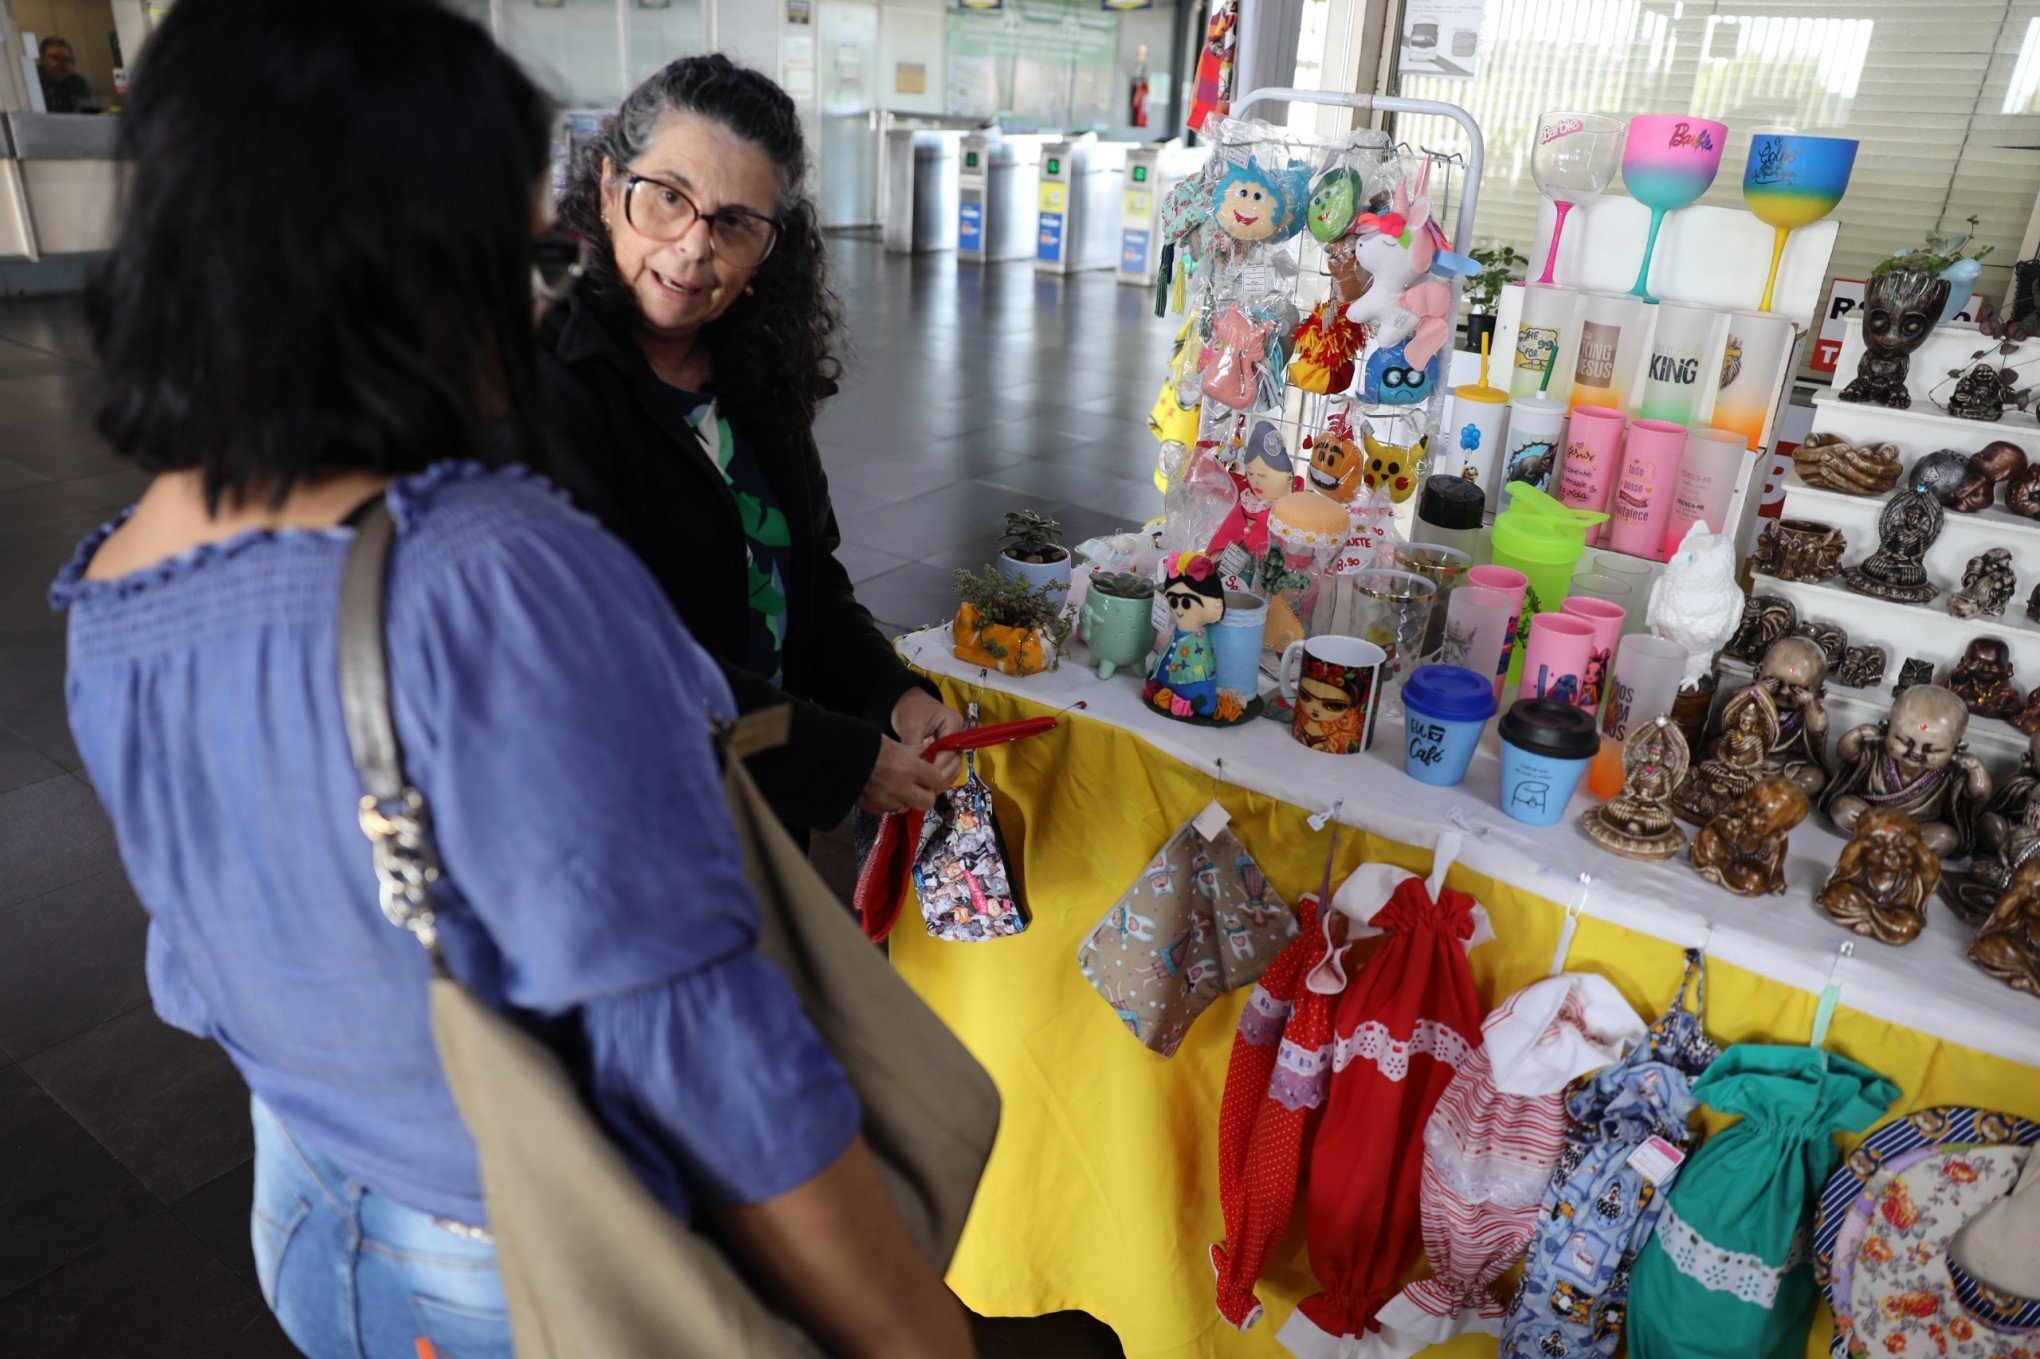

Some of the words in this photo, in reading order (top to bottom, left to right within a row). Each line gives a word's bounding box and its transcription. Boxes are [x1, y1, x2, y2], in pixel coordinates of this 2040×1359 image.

[1542, 119, 1581, 143] Barbie
[1669, 123, 1713, 151] Barbie
[1525, 347, 1538, 358] FOR
[1582, 341, 1612, 361] KING
[1577, 359, 1613, 379] JESUS
[1648, 353, 1698, 384] KING
[1336, 557, 1360, 571] 8.90
[1410, 737, 1445, 766] Café
